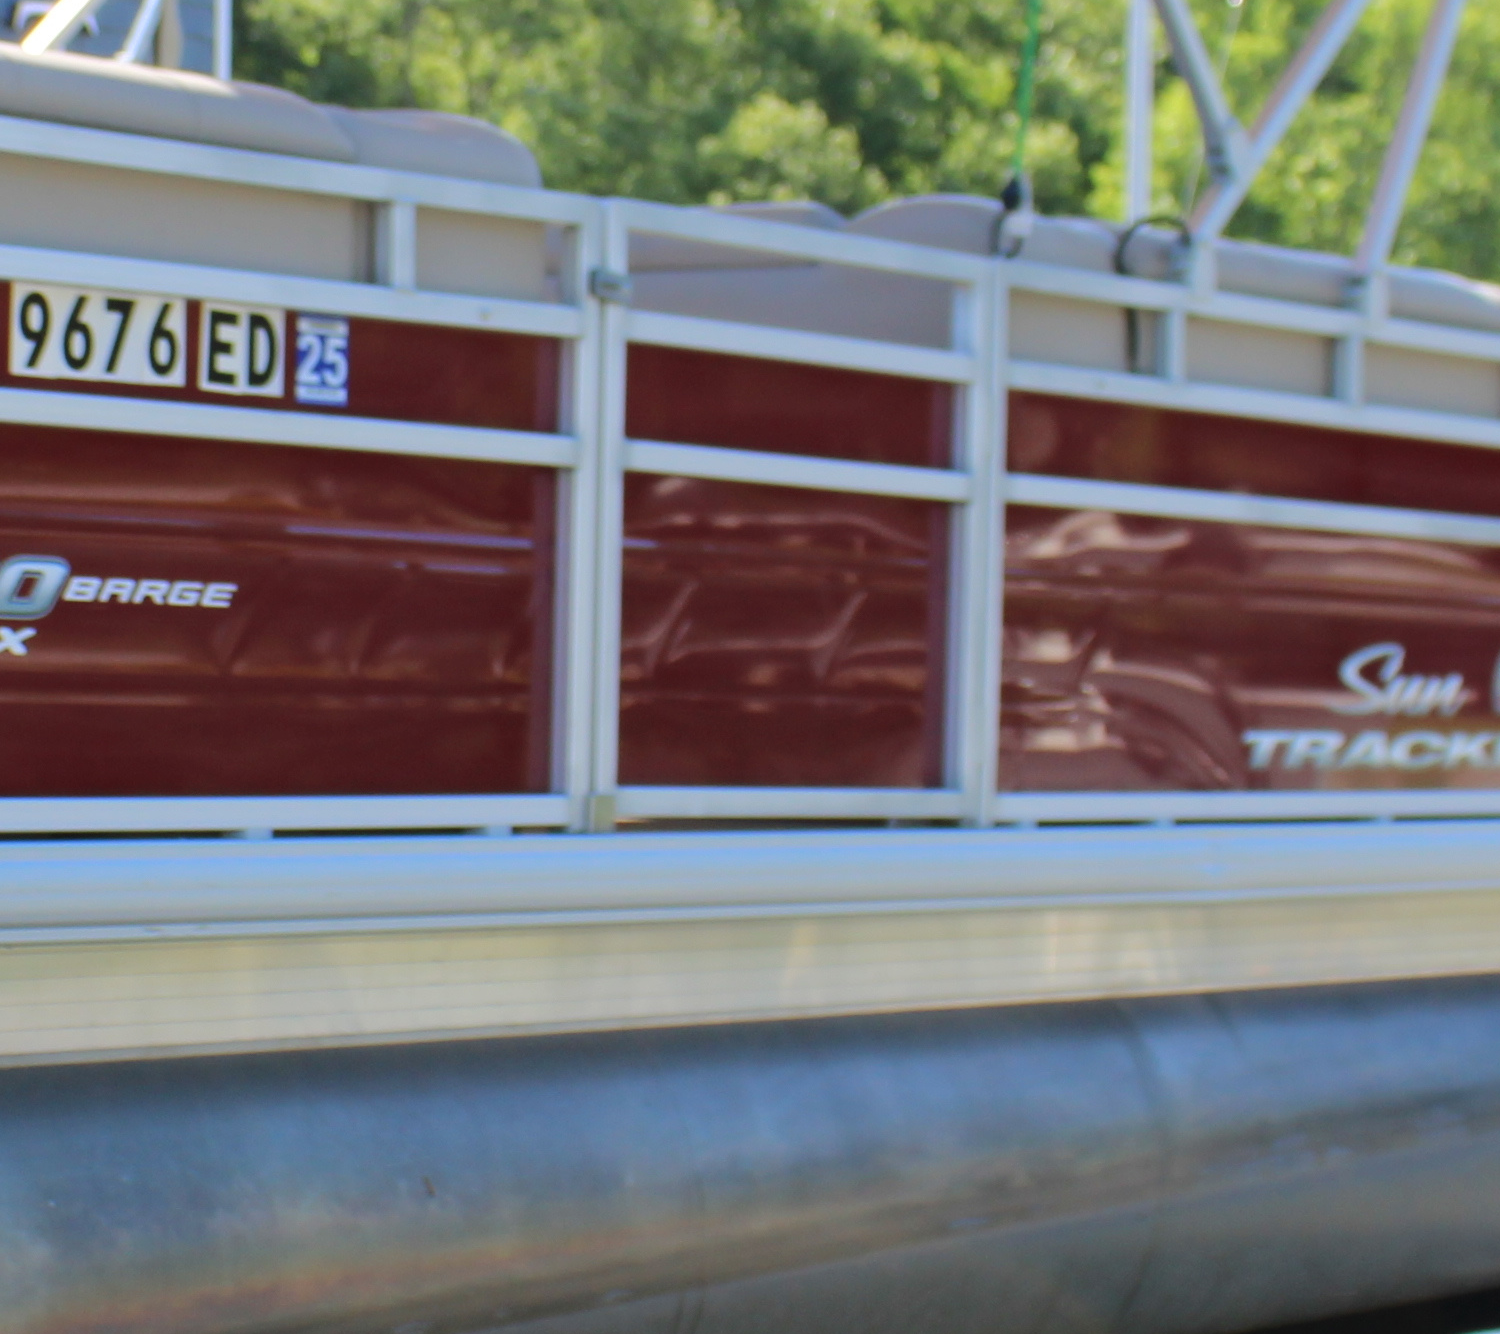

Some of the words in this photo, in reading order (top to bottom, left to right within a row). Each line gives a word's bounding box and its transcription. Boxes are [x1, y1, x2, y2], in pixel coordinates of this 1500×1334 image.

[18, 291, 180, 378] 9676
[206, 309, 278, 387] ED
[296, 334, 349, 387] 25
[62, 575, 240, 609] BARGE
[1330, 641, 1466, 717] Sun
